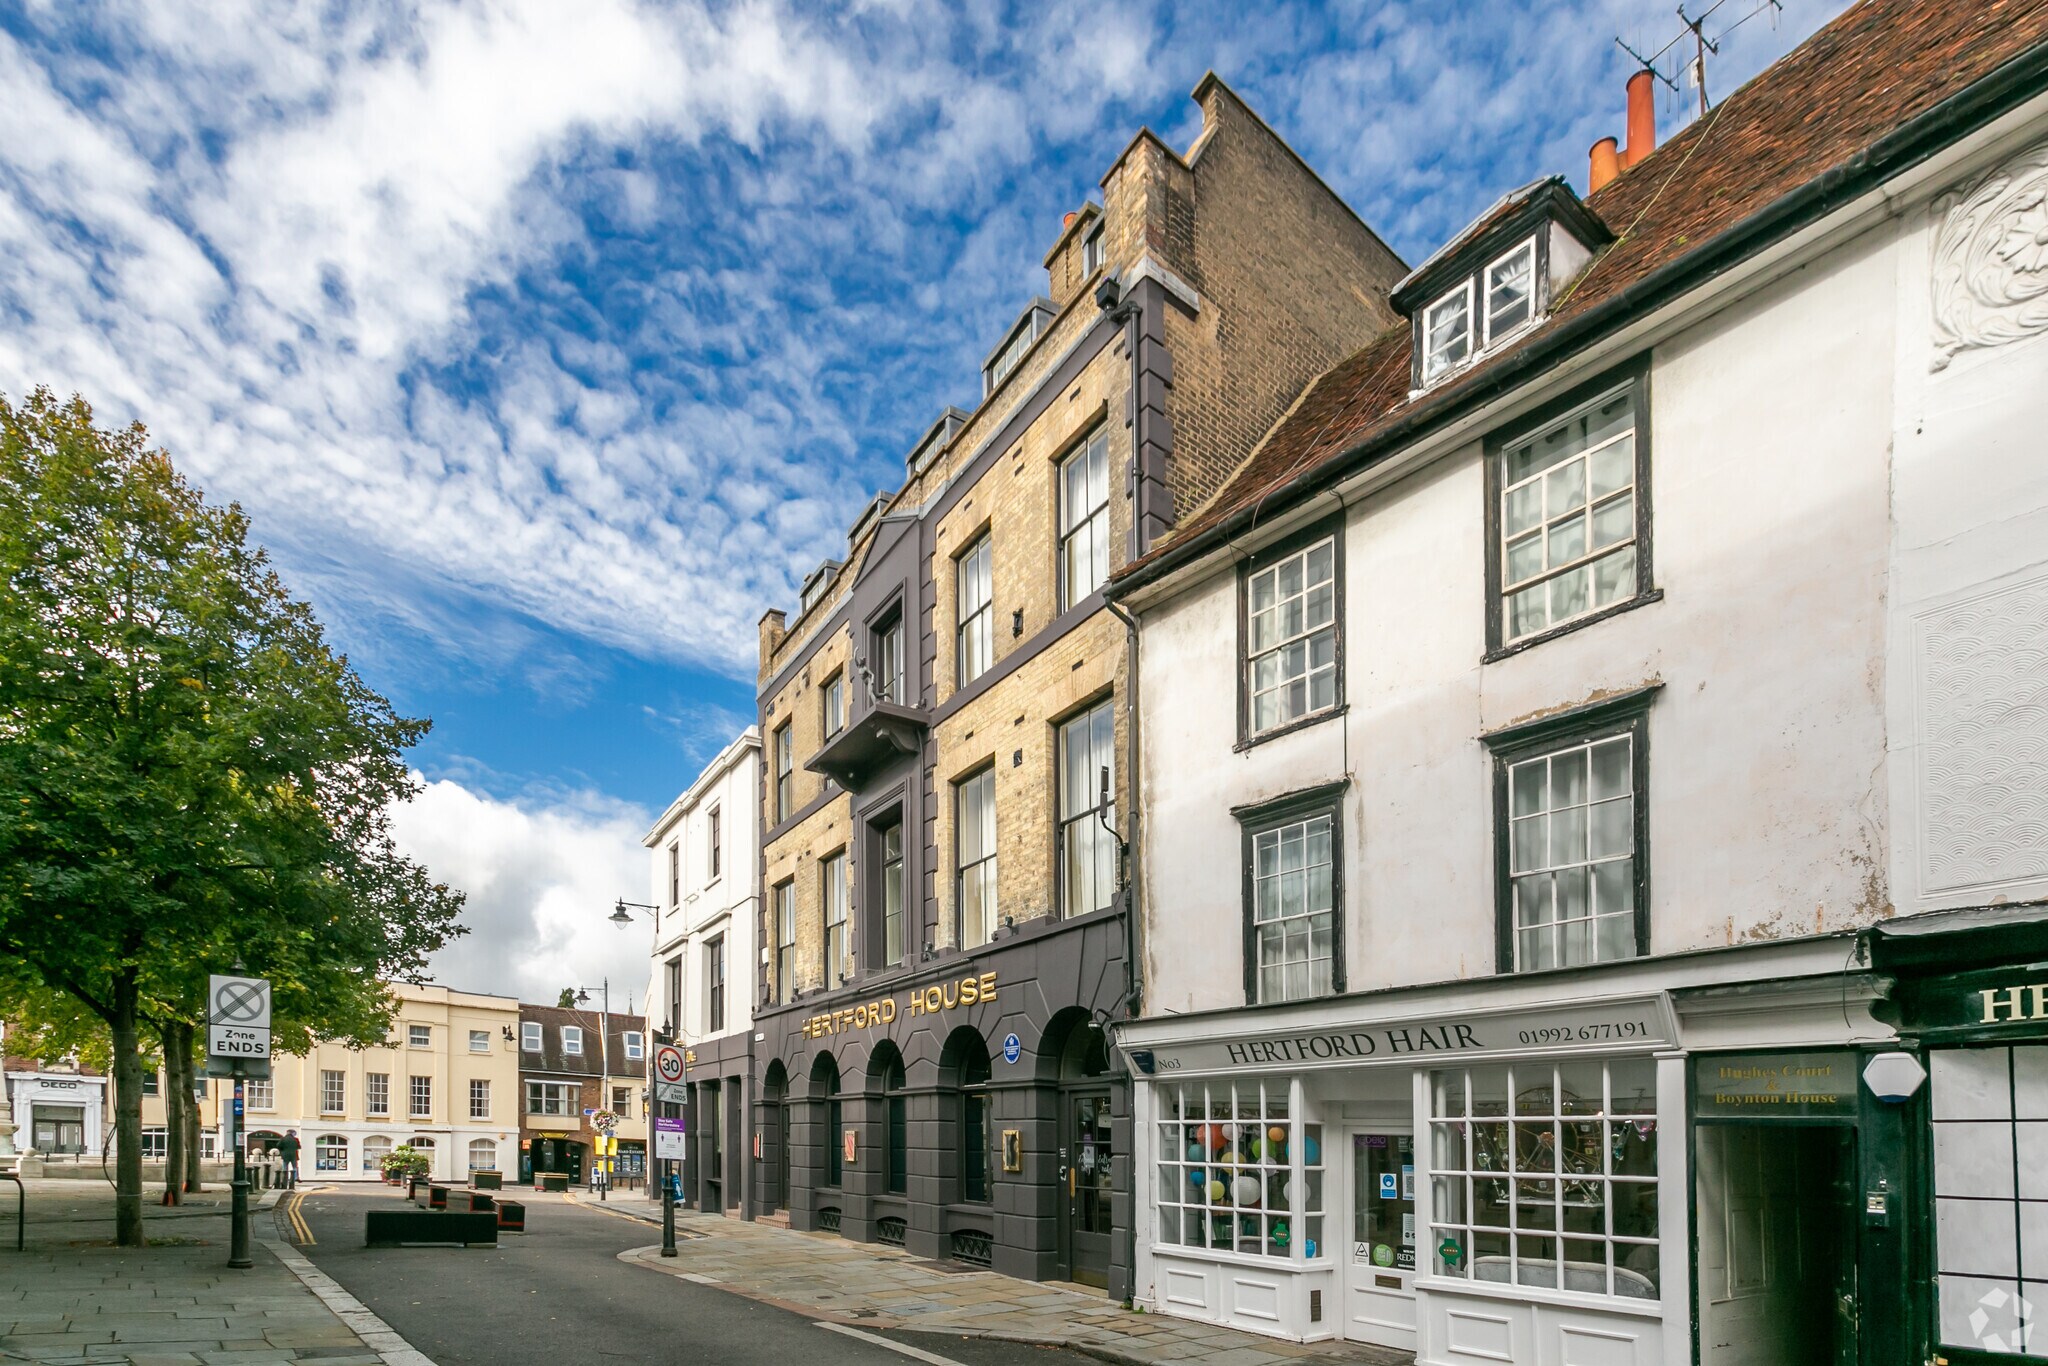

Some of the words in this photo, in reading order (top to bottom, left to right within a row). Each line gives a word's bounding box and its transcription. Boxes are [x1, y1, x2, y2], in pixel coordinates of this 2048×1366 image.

[802, 998, 896, 1040] HERTFORD
[910, 971, 997, 1017] HOUSE
[225, 1029, 256, 1040] Zone
[1518, 1027, 1574, 1044] 01992
[1578, 1021, 1649, 1040] 677191
[217, 1040, 264, 1054] ENDS
[1226, 1033, 1376, 1064] HERTFORD
[1384, 1024, 1484, 1053] HAIR
[662, 1057, 680, 1073] 30
[1719, 1066, 1777, 1079] Hughes
[1782, 1064, 1832, 1077] Court
[40, 1081, 77, 1089] DECO
[1766, 1079, 1778, 1092] &
[1715, 1092, 1780, 1107] Boynton
[1785, 1091, 1837, 1104] House
